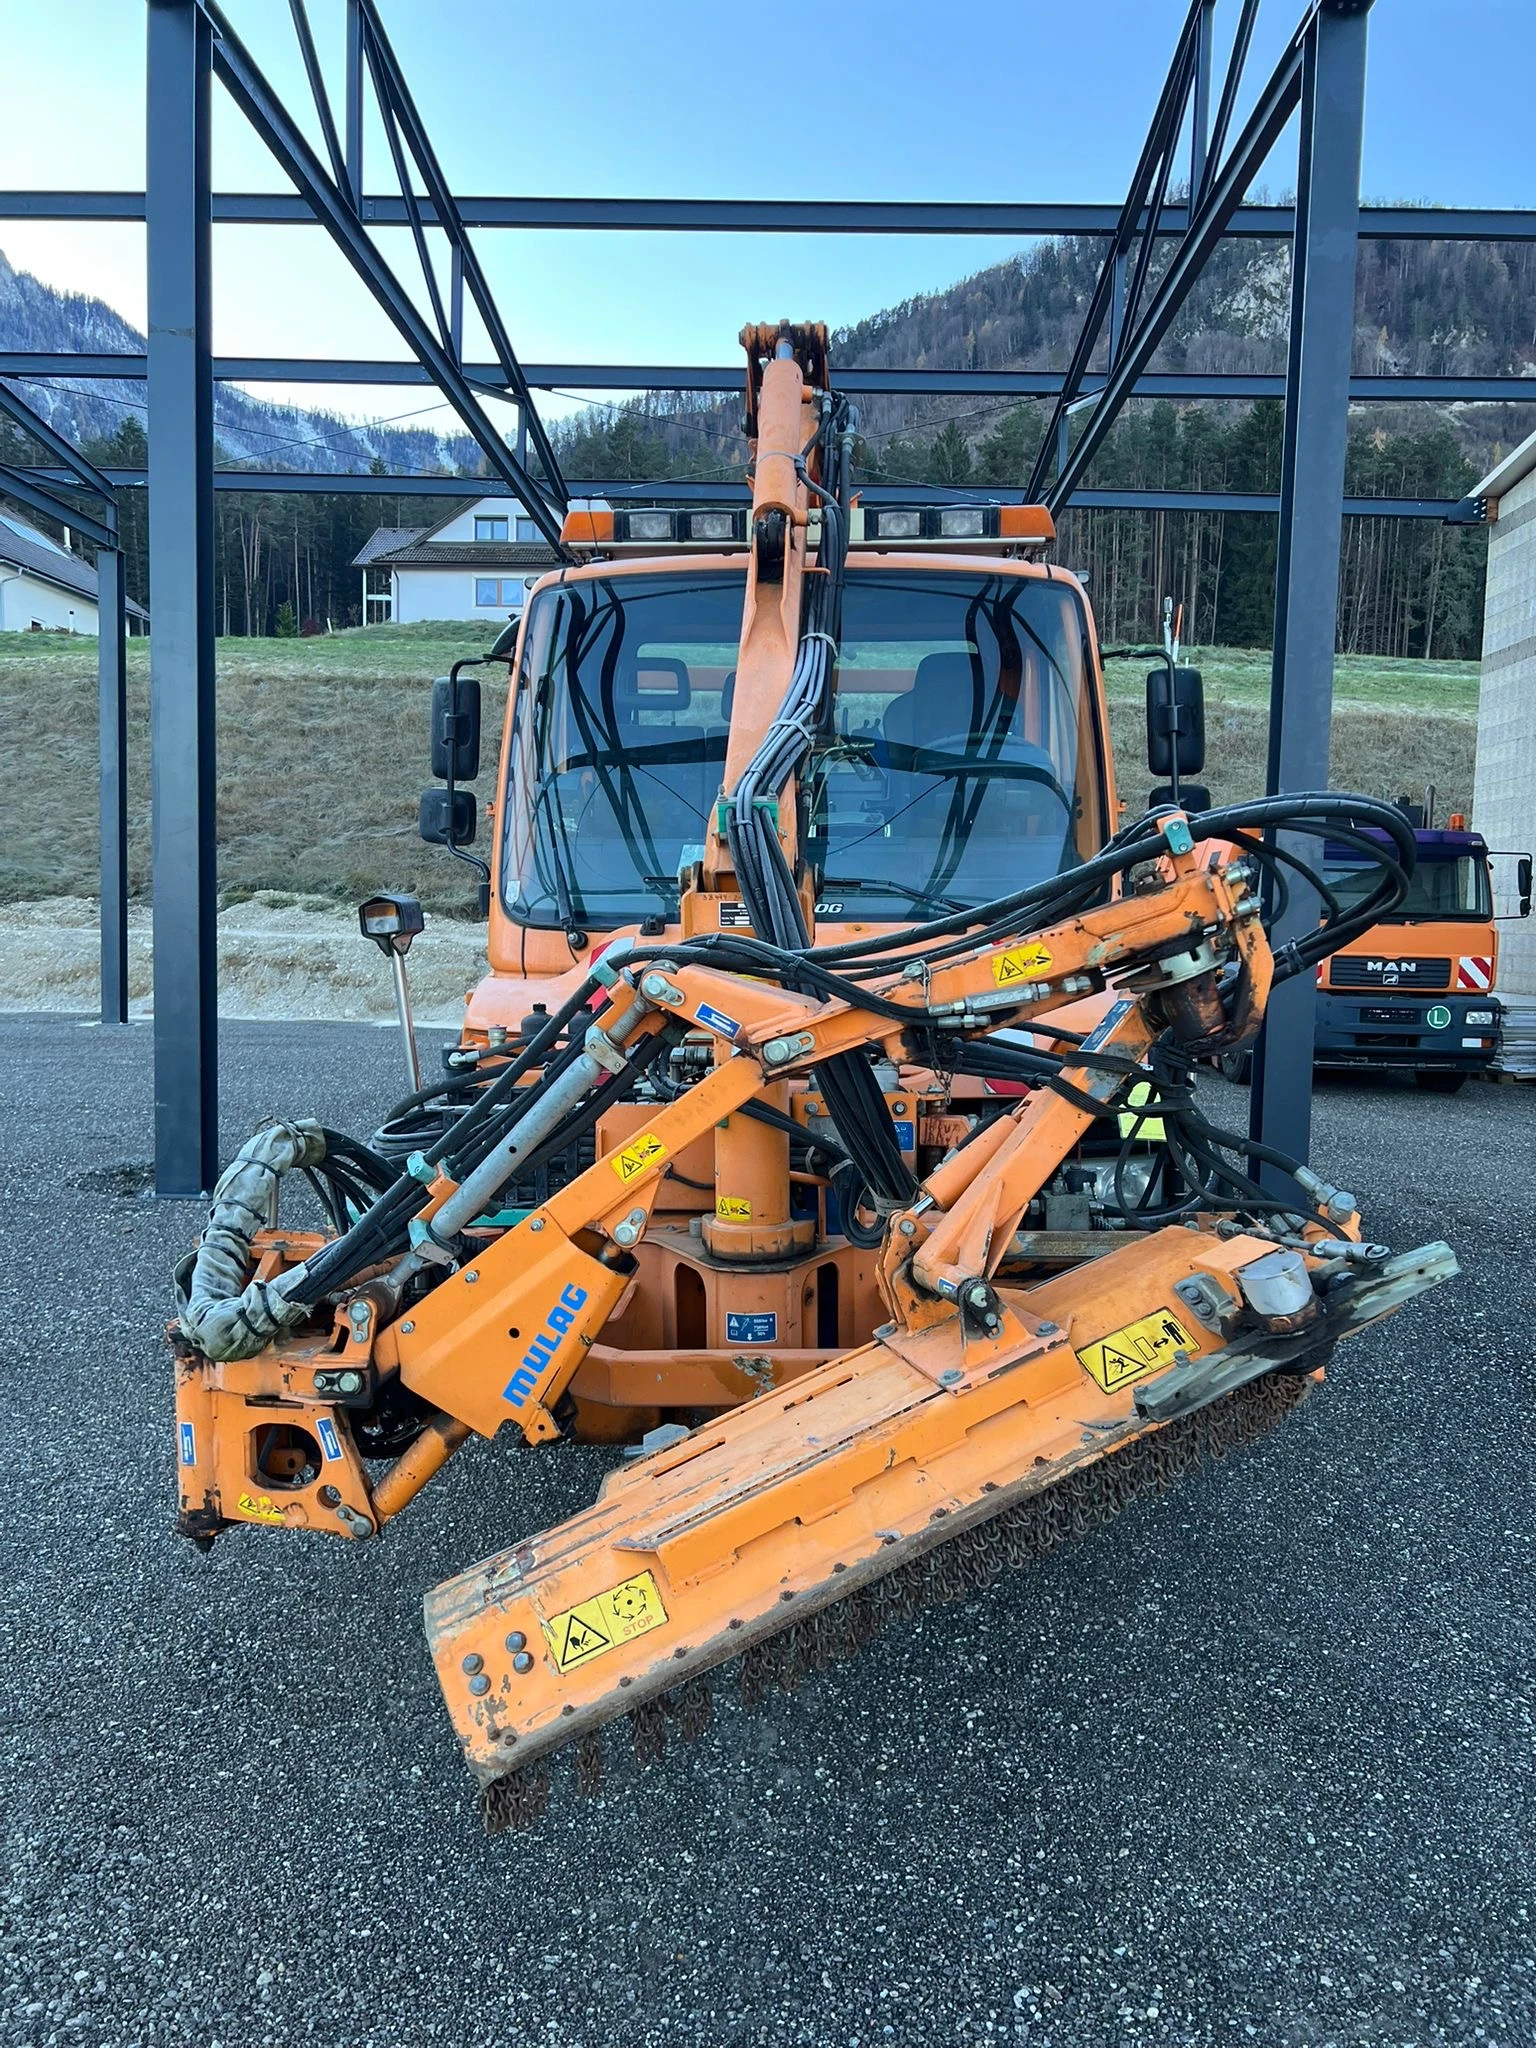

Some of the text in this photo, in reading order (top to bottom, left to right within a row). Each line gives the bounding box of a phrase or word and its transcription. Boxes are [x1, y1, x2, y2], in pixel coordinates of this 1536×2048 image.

[814, 903, 844, 913] OG
[1366, 961, 1417, 972] MAN
[1433, 1010, 1444, 1025] L
[502, 1282, 588, 1408] MULAG
[622, 1614, 654, 1636] STOP
